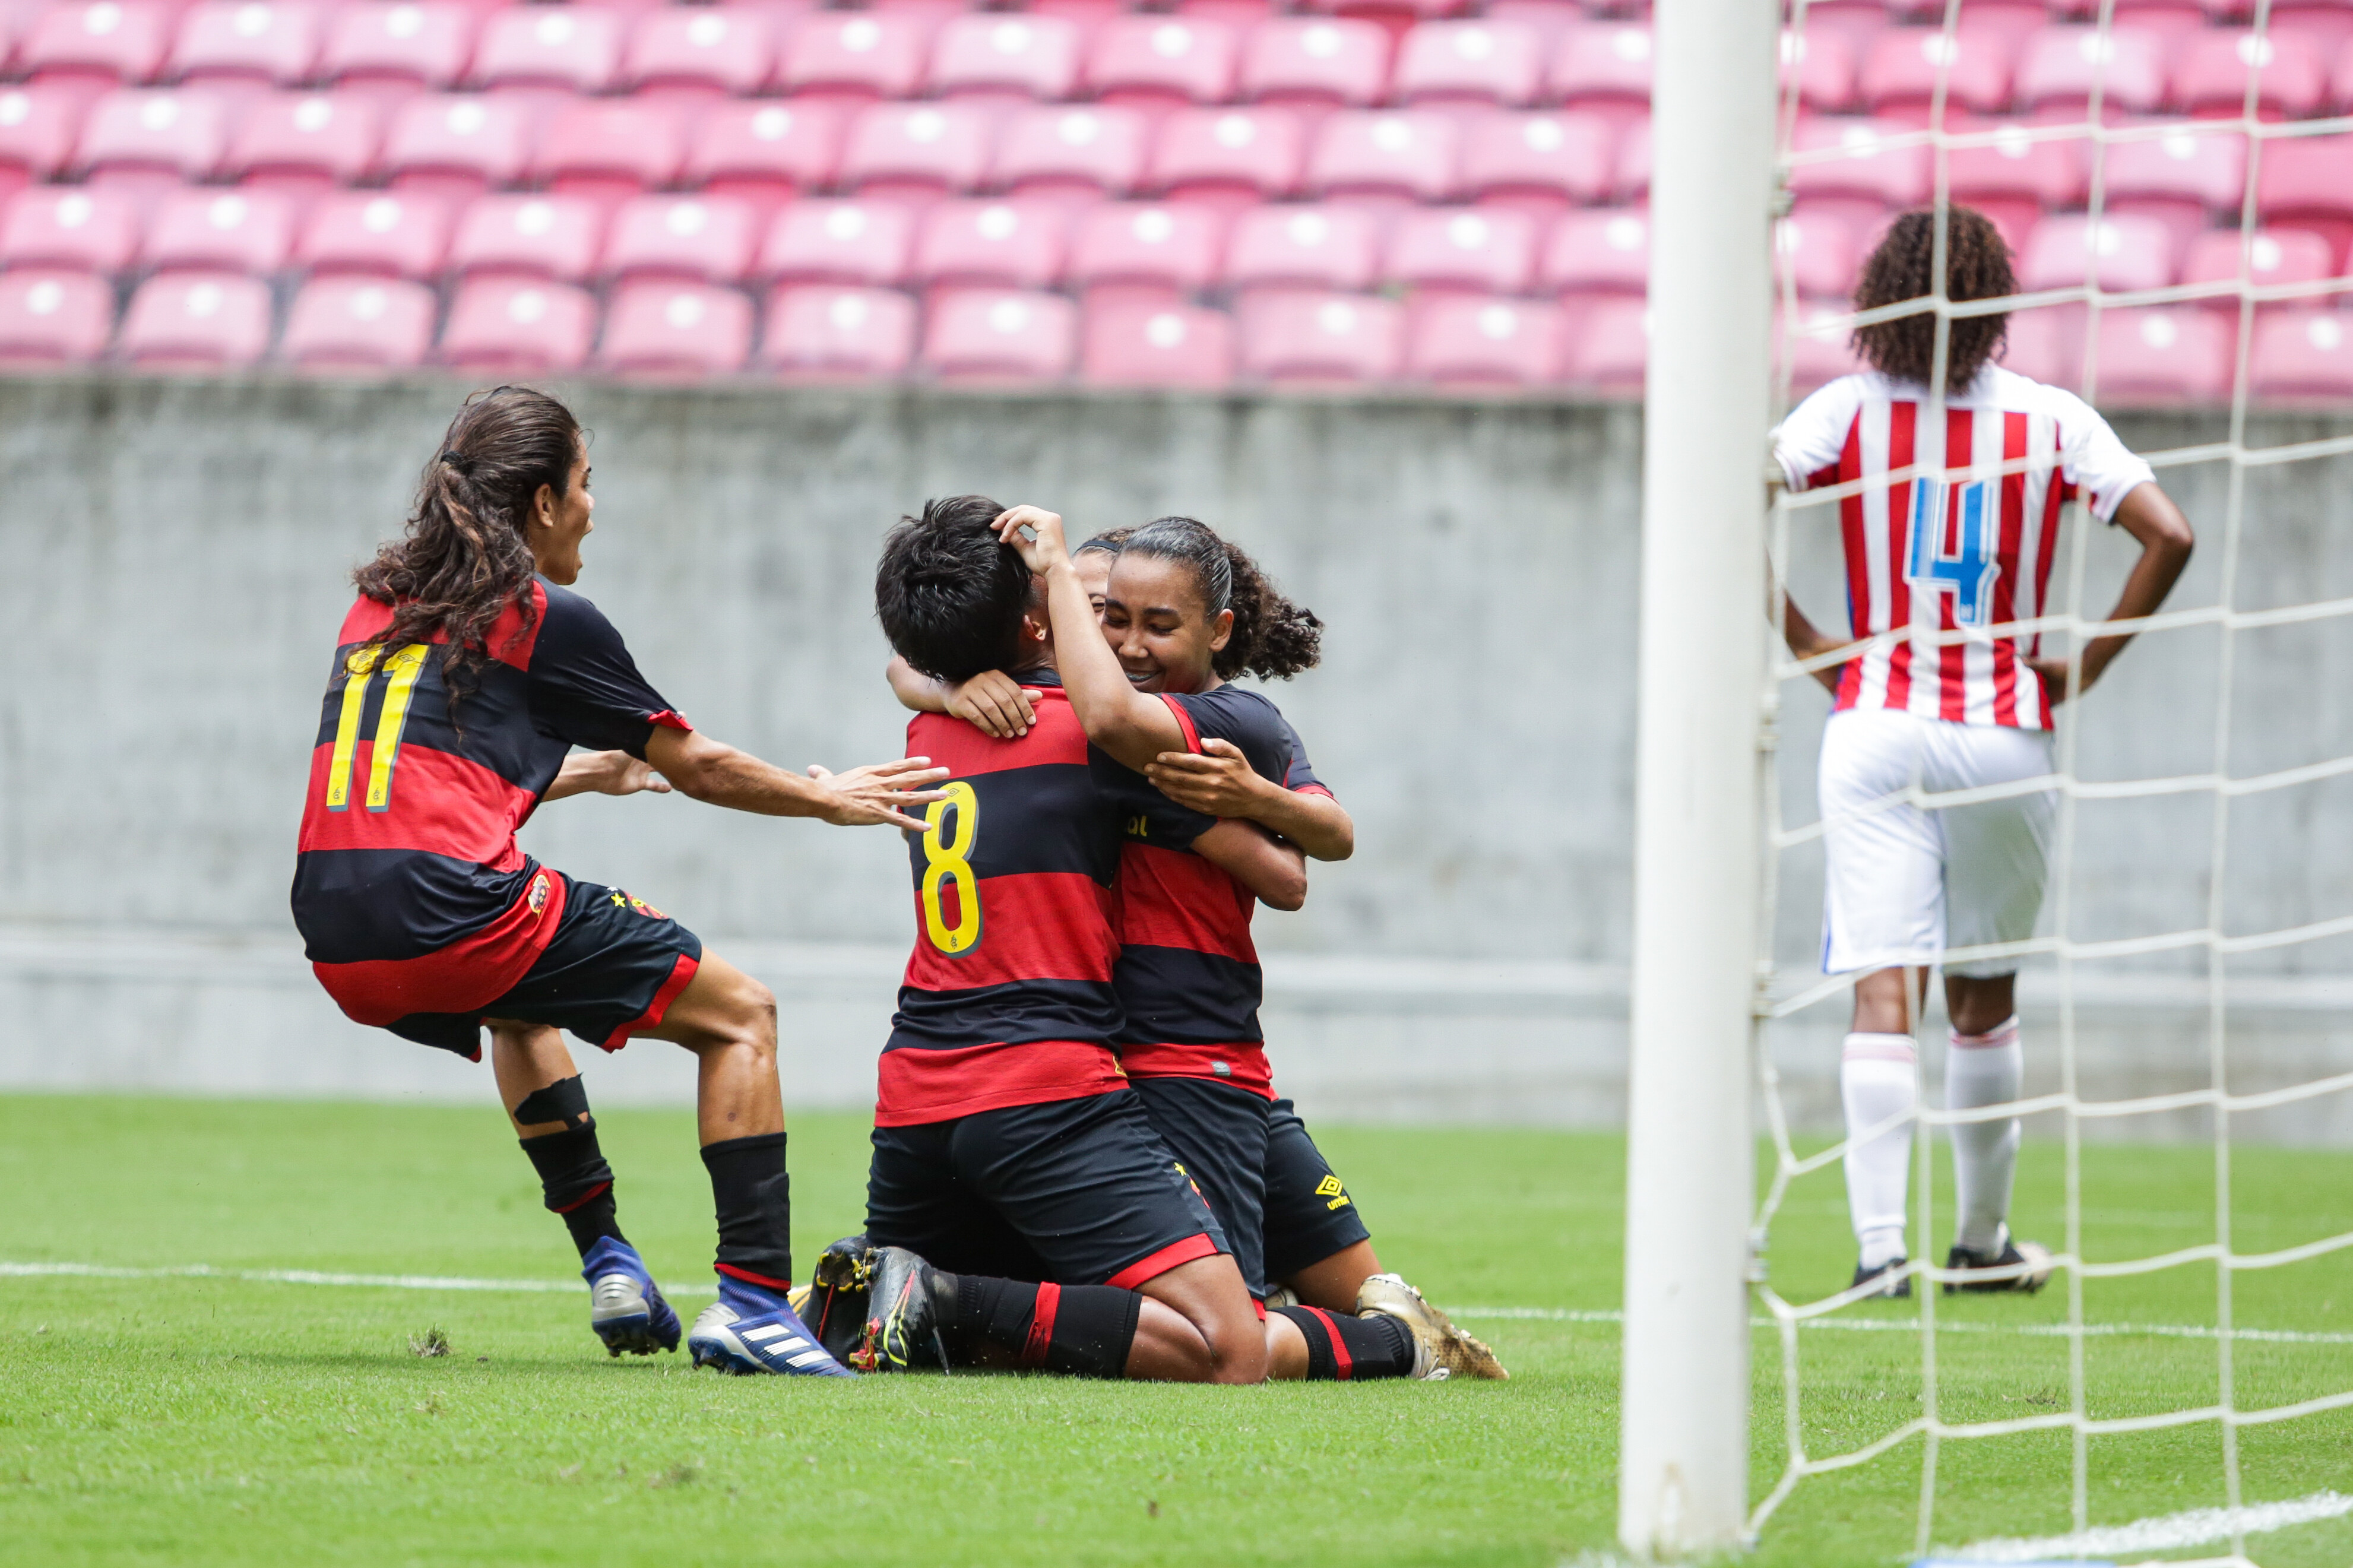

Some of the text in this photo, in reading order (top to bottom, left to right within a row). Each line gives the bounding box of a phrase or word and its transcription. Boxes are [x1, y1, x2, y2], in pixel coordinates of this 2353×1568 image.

[1903, 475, 2002, 629] 4
[326, 643, 429, 813] 11
[922, 781, 984, 959] 8
